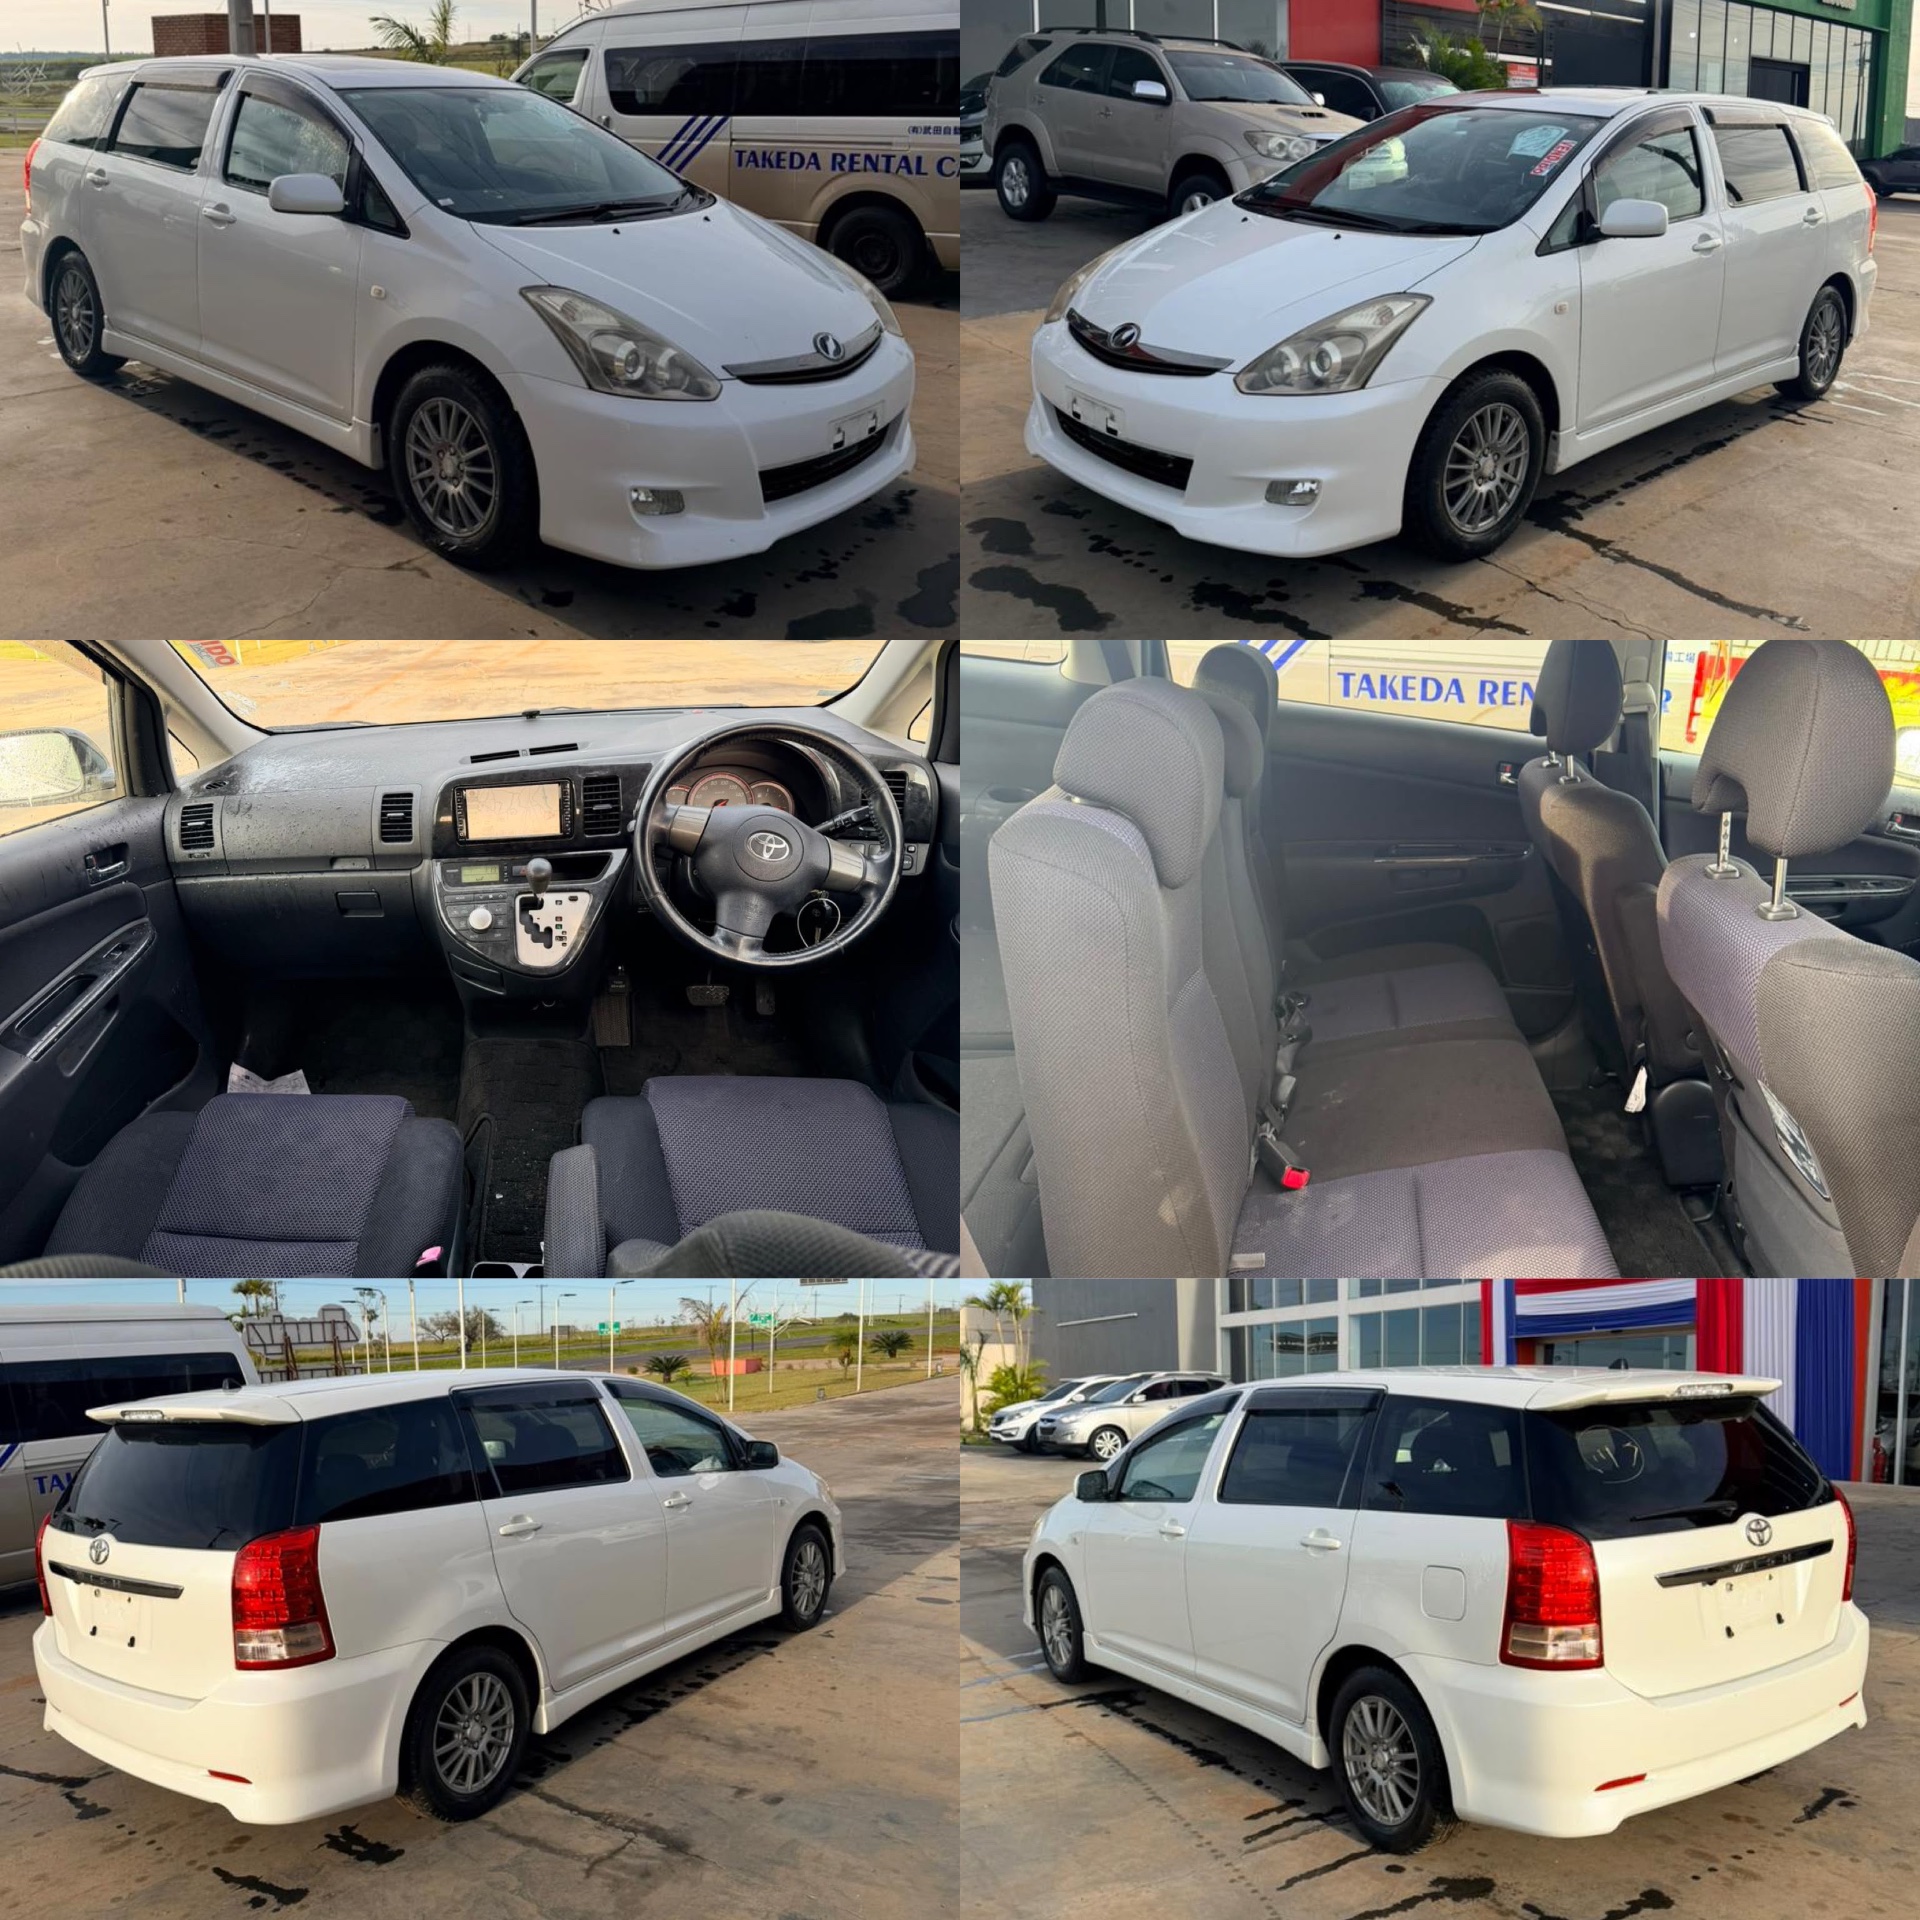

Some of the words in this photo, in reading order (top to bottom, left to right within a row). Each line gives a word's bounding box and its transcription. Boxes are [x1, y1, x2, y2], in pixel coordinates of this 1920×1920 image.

[735, 150, 821, 170] TAKEDA
[831, 153, 929, 175] RENTAL
[1337, 672, 1465, 703] TAKEDA
